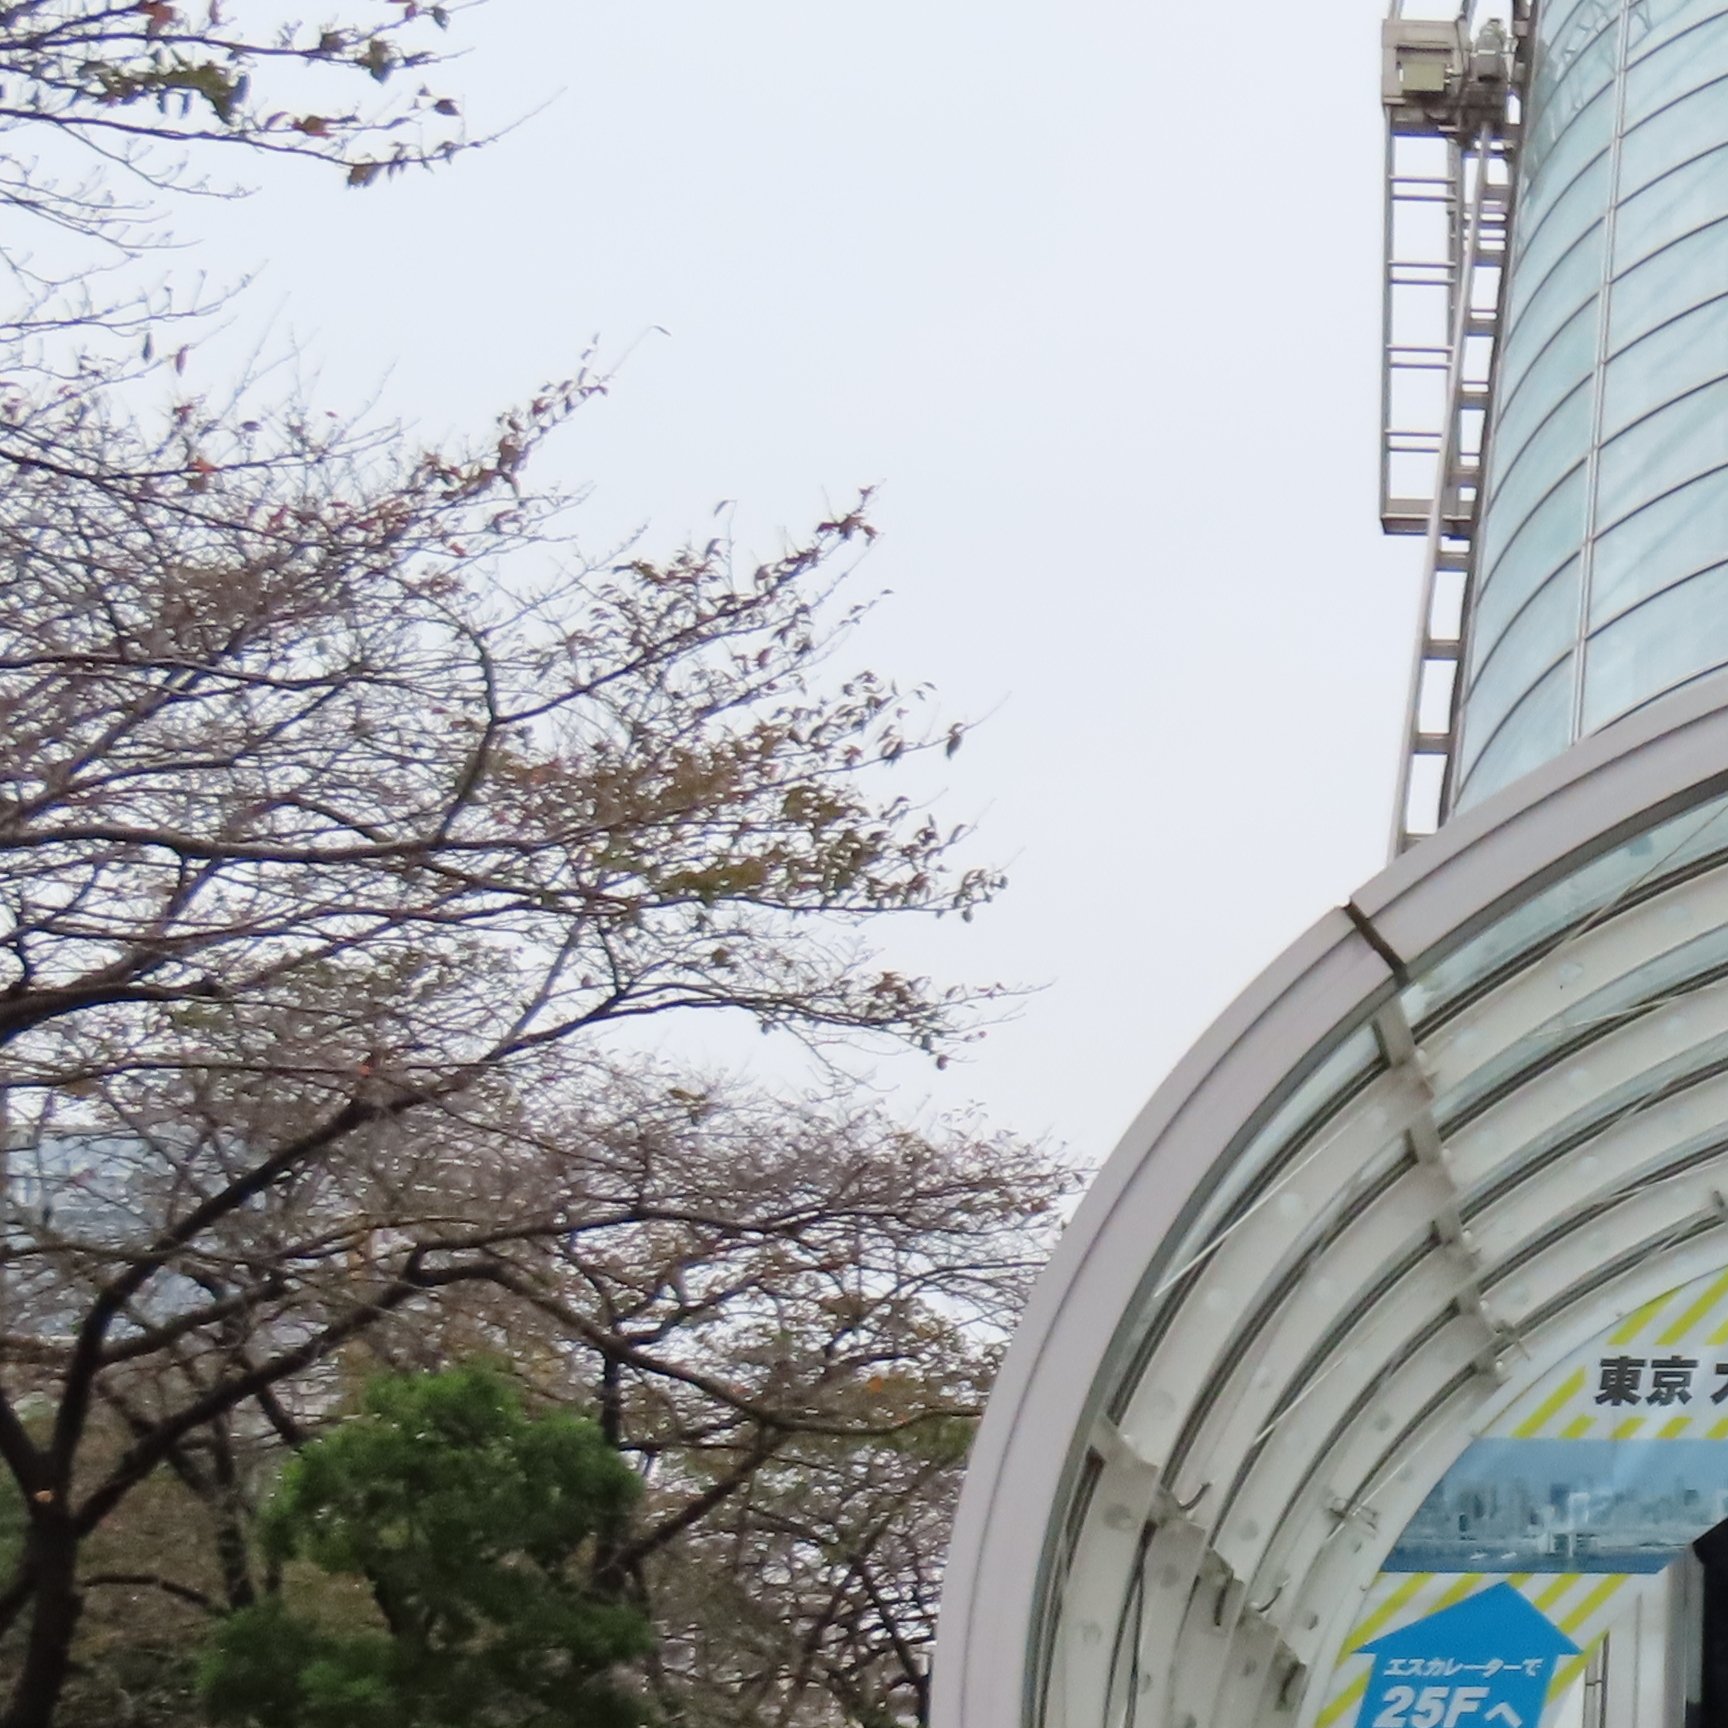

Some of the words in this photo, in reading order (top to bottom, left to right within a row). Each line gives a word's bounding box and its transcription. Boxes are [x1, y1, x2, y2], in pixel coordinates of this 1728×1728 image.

[1383, 1656, 1544, 1679] エスカレーターで
